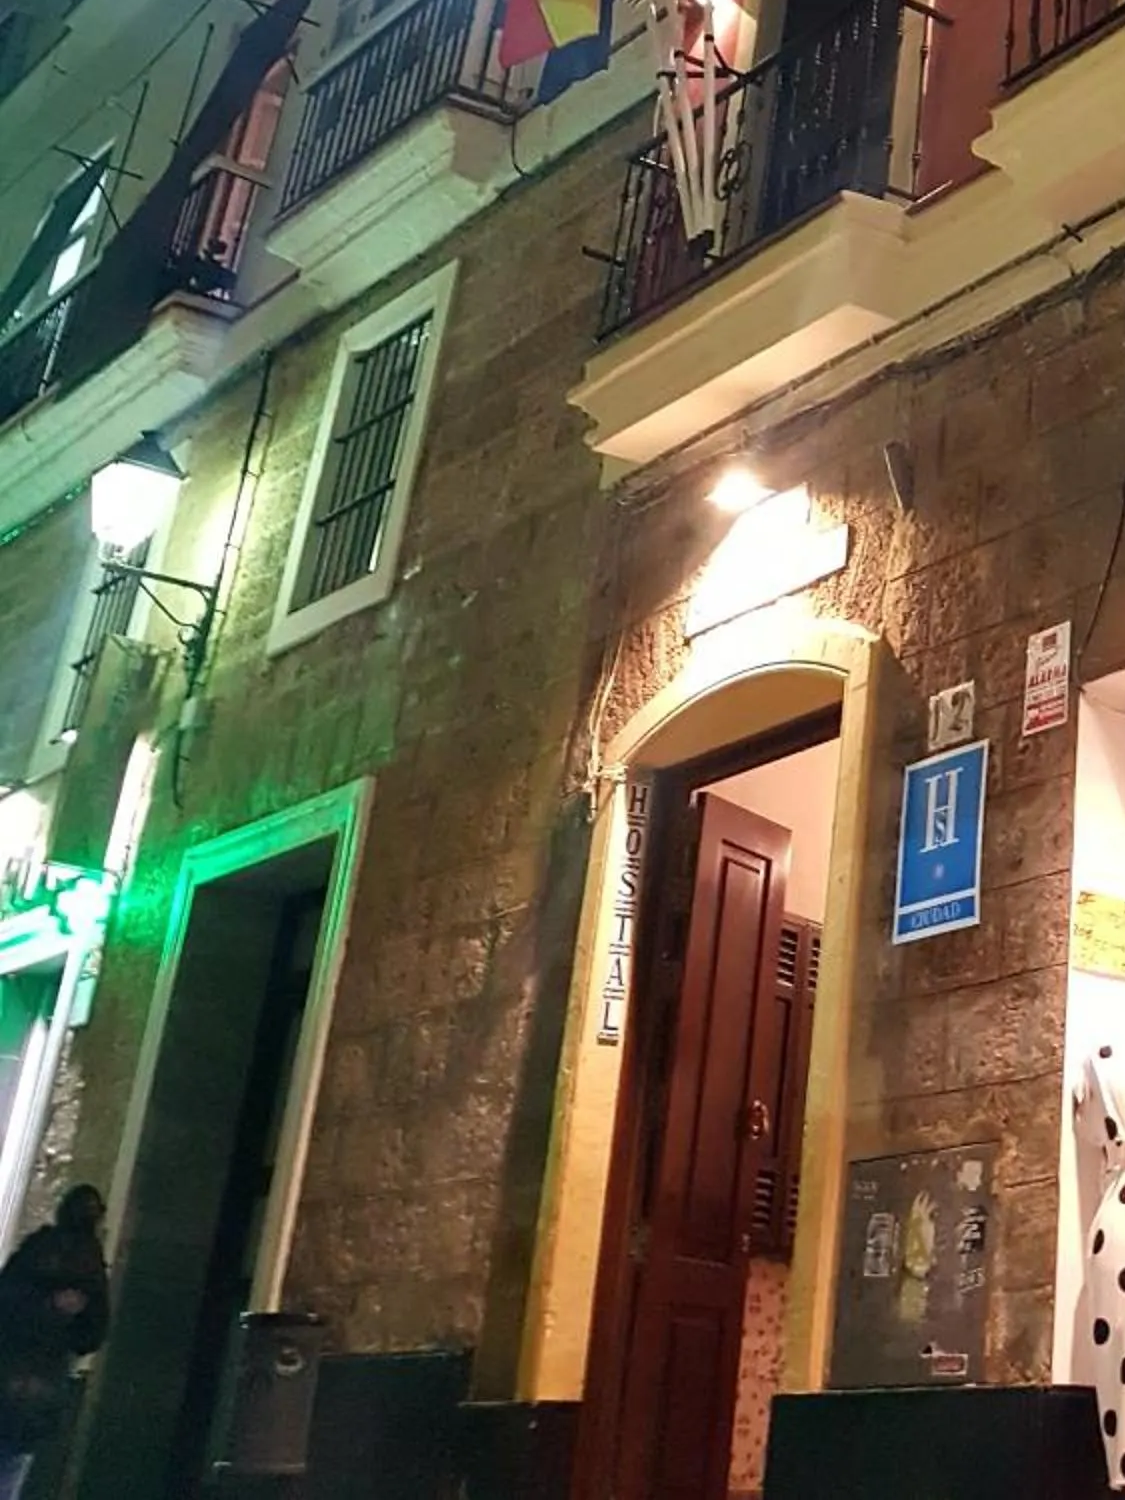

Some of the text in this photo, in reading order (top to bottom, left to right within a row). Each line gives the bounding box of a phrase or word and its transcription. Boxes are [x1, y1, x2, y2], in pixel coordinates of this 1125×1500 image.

[932, 690, 971, 741] 12
[602, 786, 648, 1031] HOSTAL
[911, 901, 961, 928] CIUDAD
